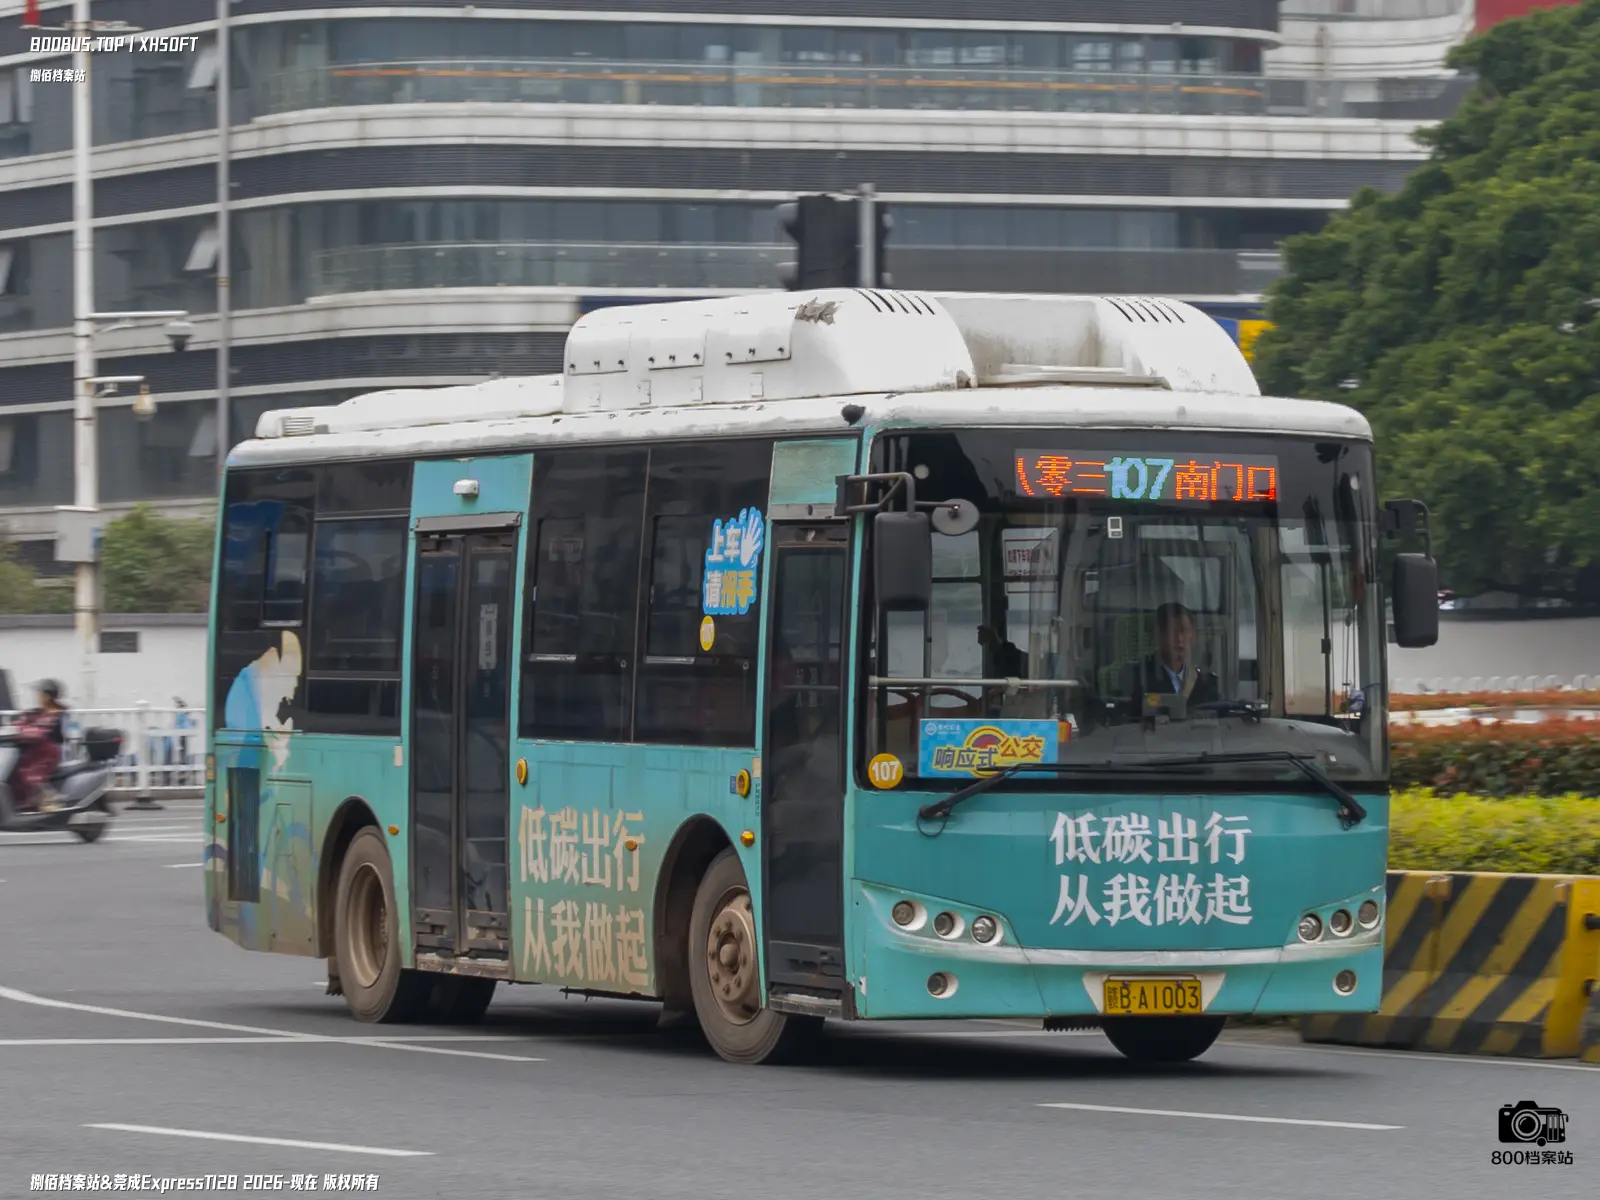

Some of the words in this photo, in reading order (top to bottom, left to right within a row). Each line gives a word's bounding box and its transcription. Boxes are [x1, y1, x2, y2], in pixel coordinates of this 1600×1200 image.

[1174, 460, 1277, 501] 南门口
[708, 525, 741, 563] 上车
[872, 761, 900, 782] 107
[935, 746, 999, 769] 响应式
[1000, 735, 1045, 758] 公交
[518, 805, 646, 892] 低碳出行
[1049, 811, 1252, 866] 低碳出行
[1049, 872, 1253, 927] 从我做起
[522, 896, 648, 986] 从我做起
